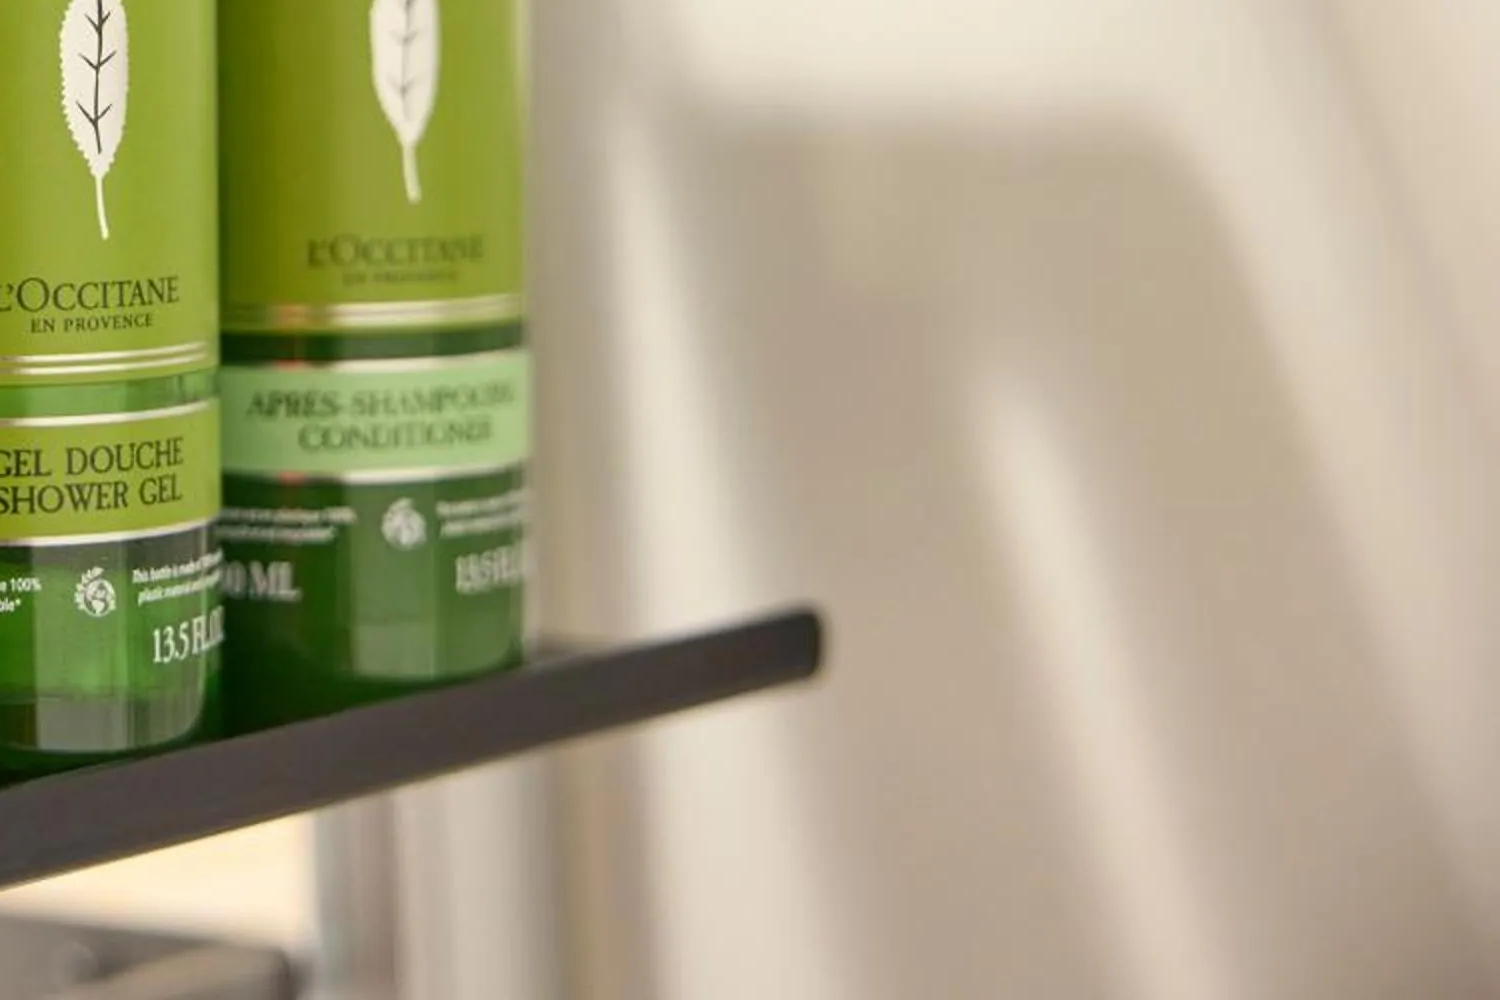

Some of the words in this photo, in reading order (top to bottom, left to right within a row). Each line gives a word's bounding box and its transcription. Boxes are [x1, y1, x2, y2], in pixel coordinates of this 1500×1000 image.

[30, 317, 56, 334] EN
[64, 312, 153, 333] PROVENCE
[65, 436, 184, 476] DOUCHE
[138, 474, 183, 505] GEL
[10, 577, 41, 592] 100%
[152, 622, 189, 664] 13.5
